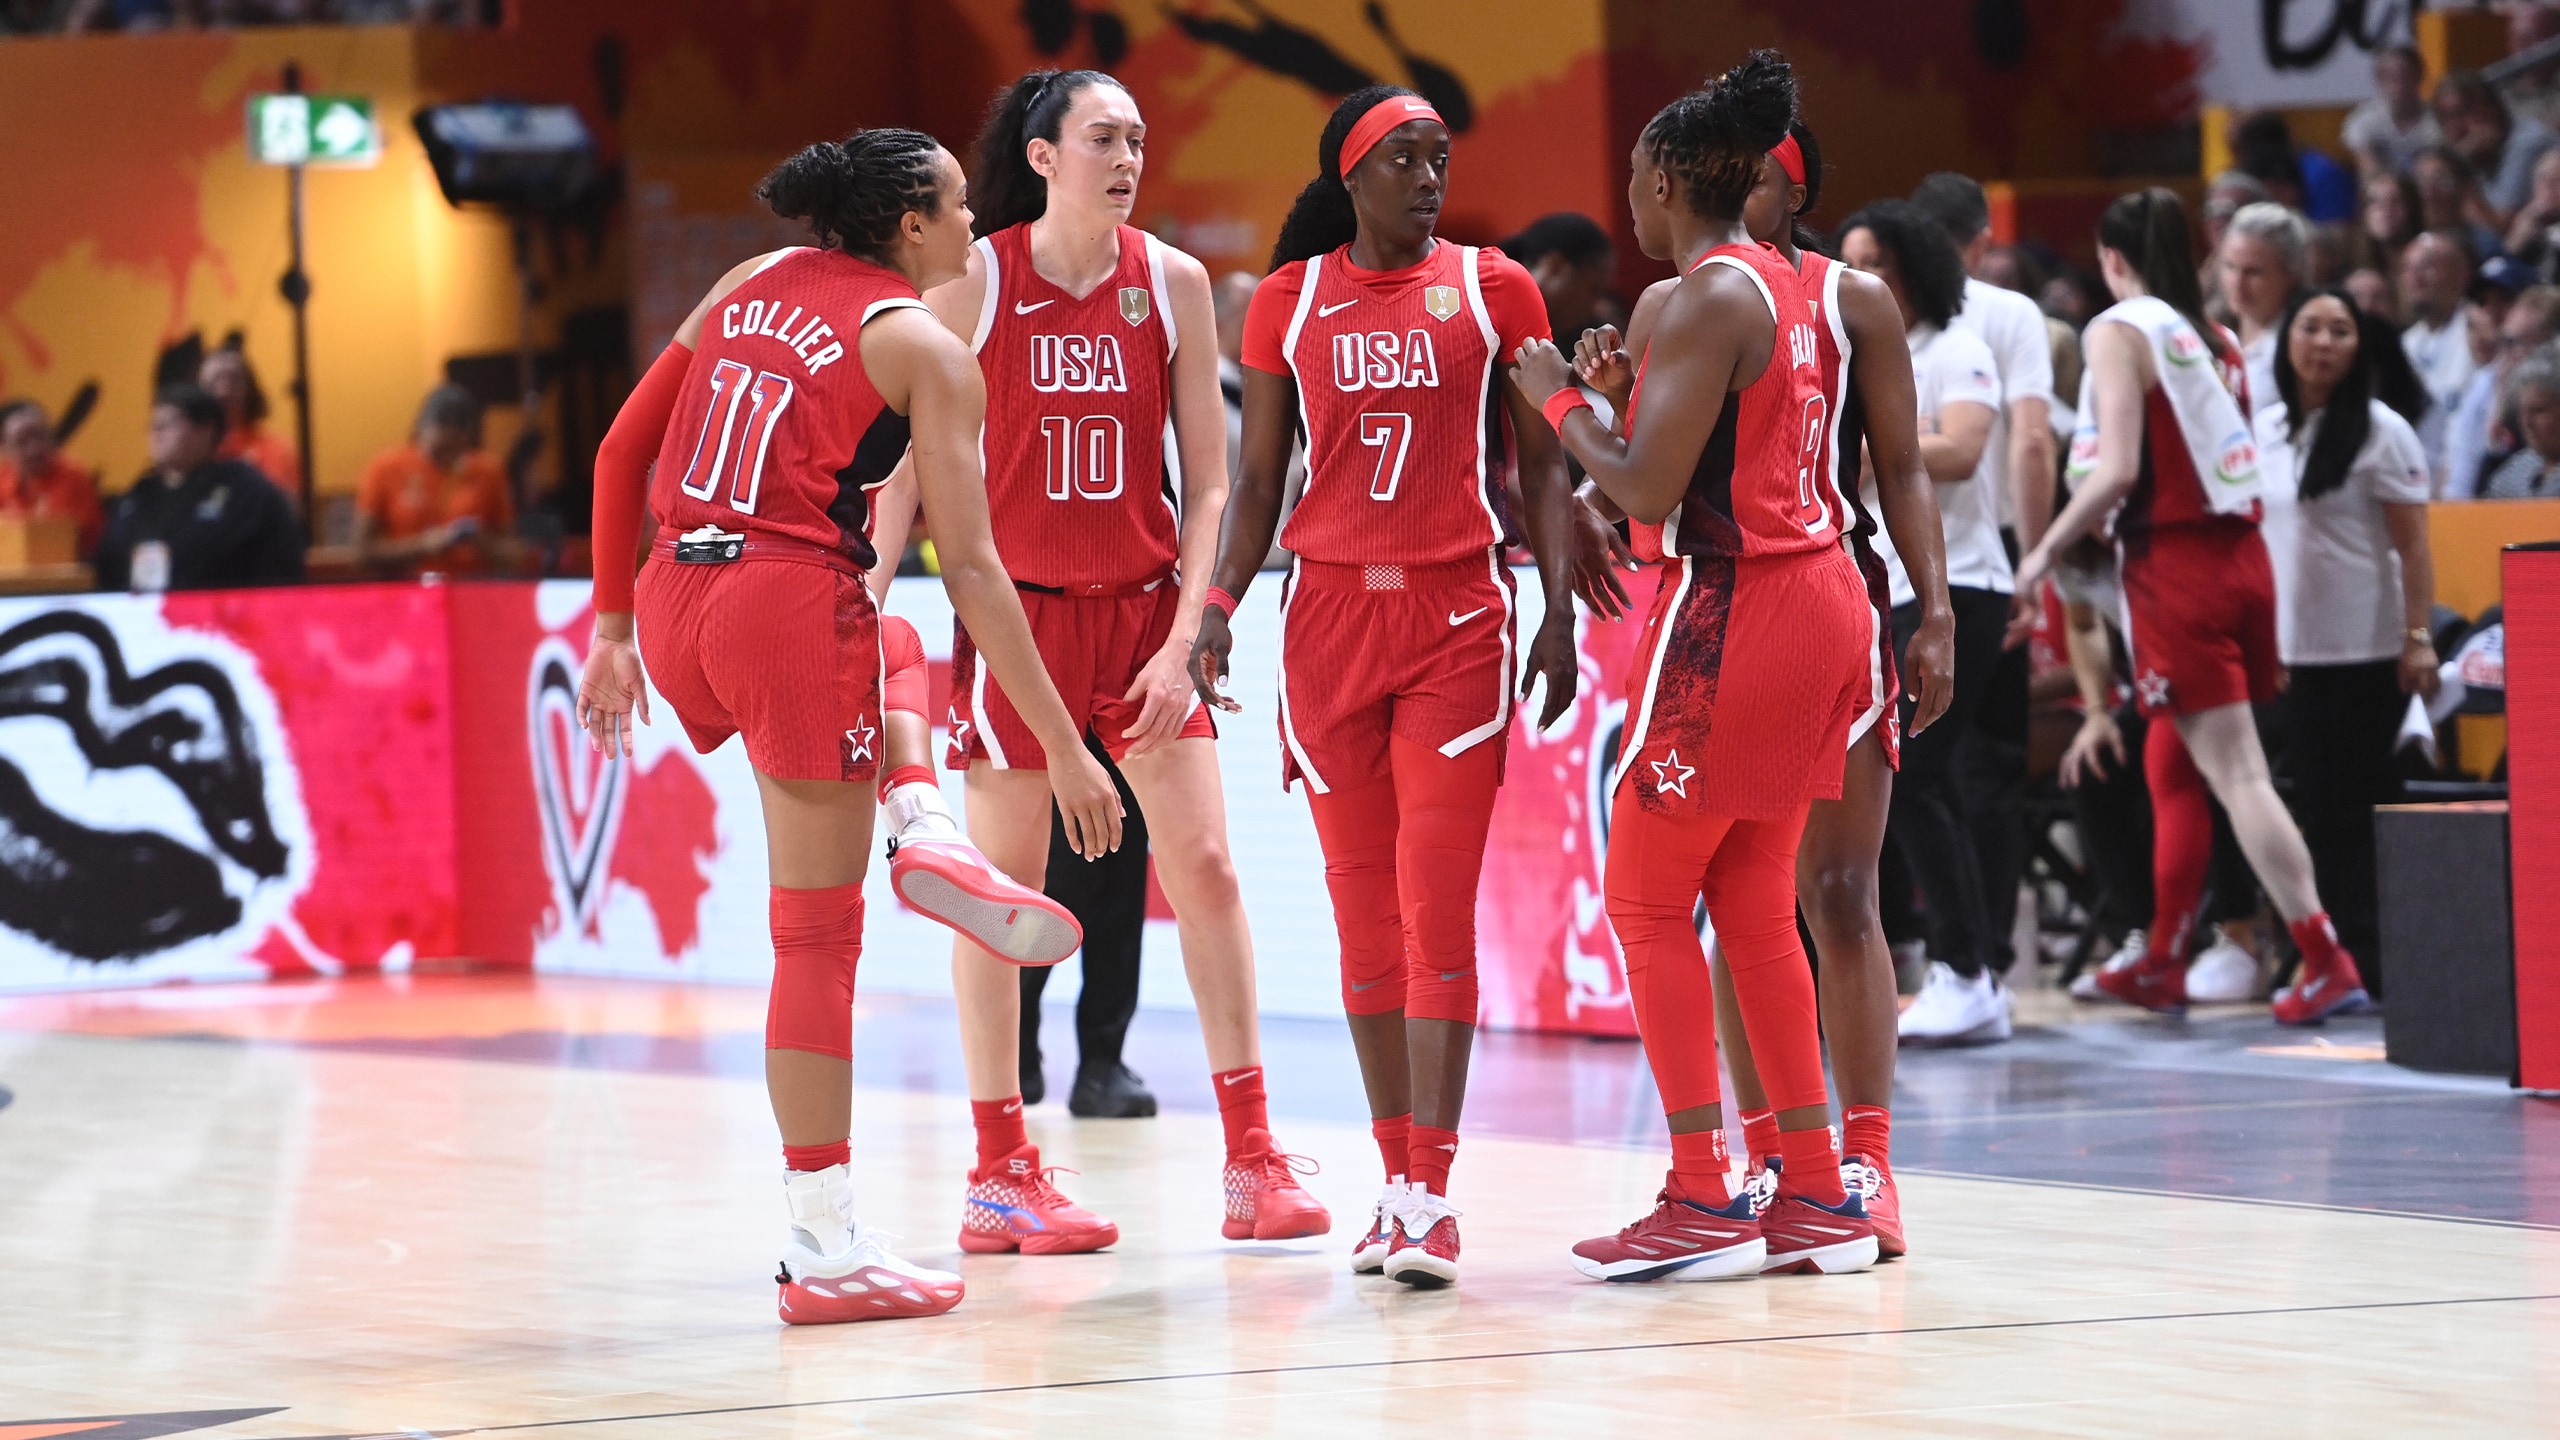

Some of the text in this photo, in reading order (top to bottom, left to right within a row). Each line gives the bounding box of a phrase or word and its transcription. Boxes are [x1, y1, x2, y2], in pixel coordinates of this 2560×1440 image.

[723, 300, 844, 376] COLLIER
[1031, 334, 1128, 392] USA
[1332, 329, 1440, 392] USA
[1789, 323, 1817, 371] GRAY
[681, 358, 794, 515] 11
[1041, 415, 1124, 500] 10
[1360, 412, 1412, 501] 7
